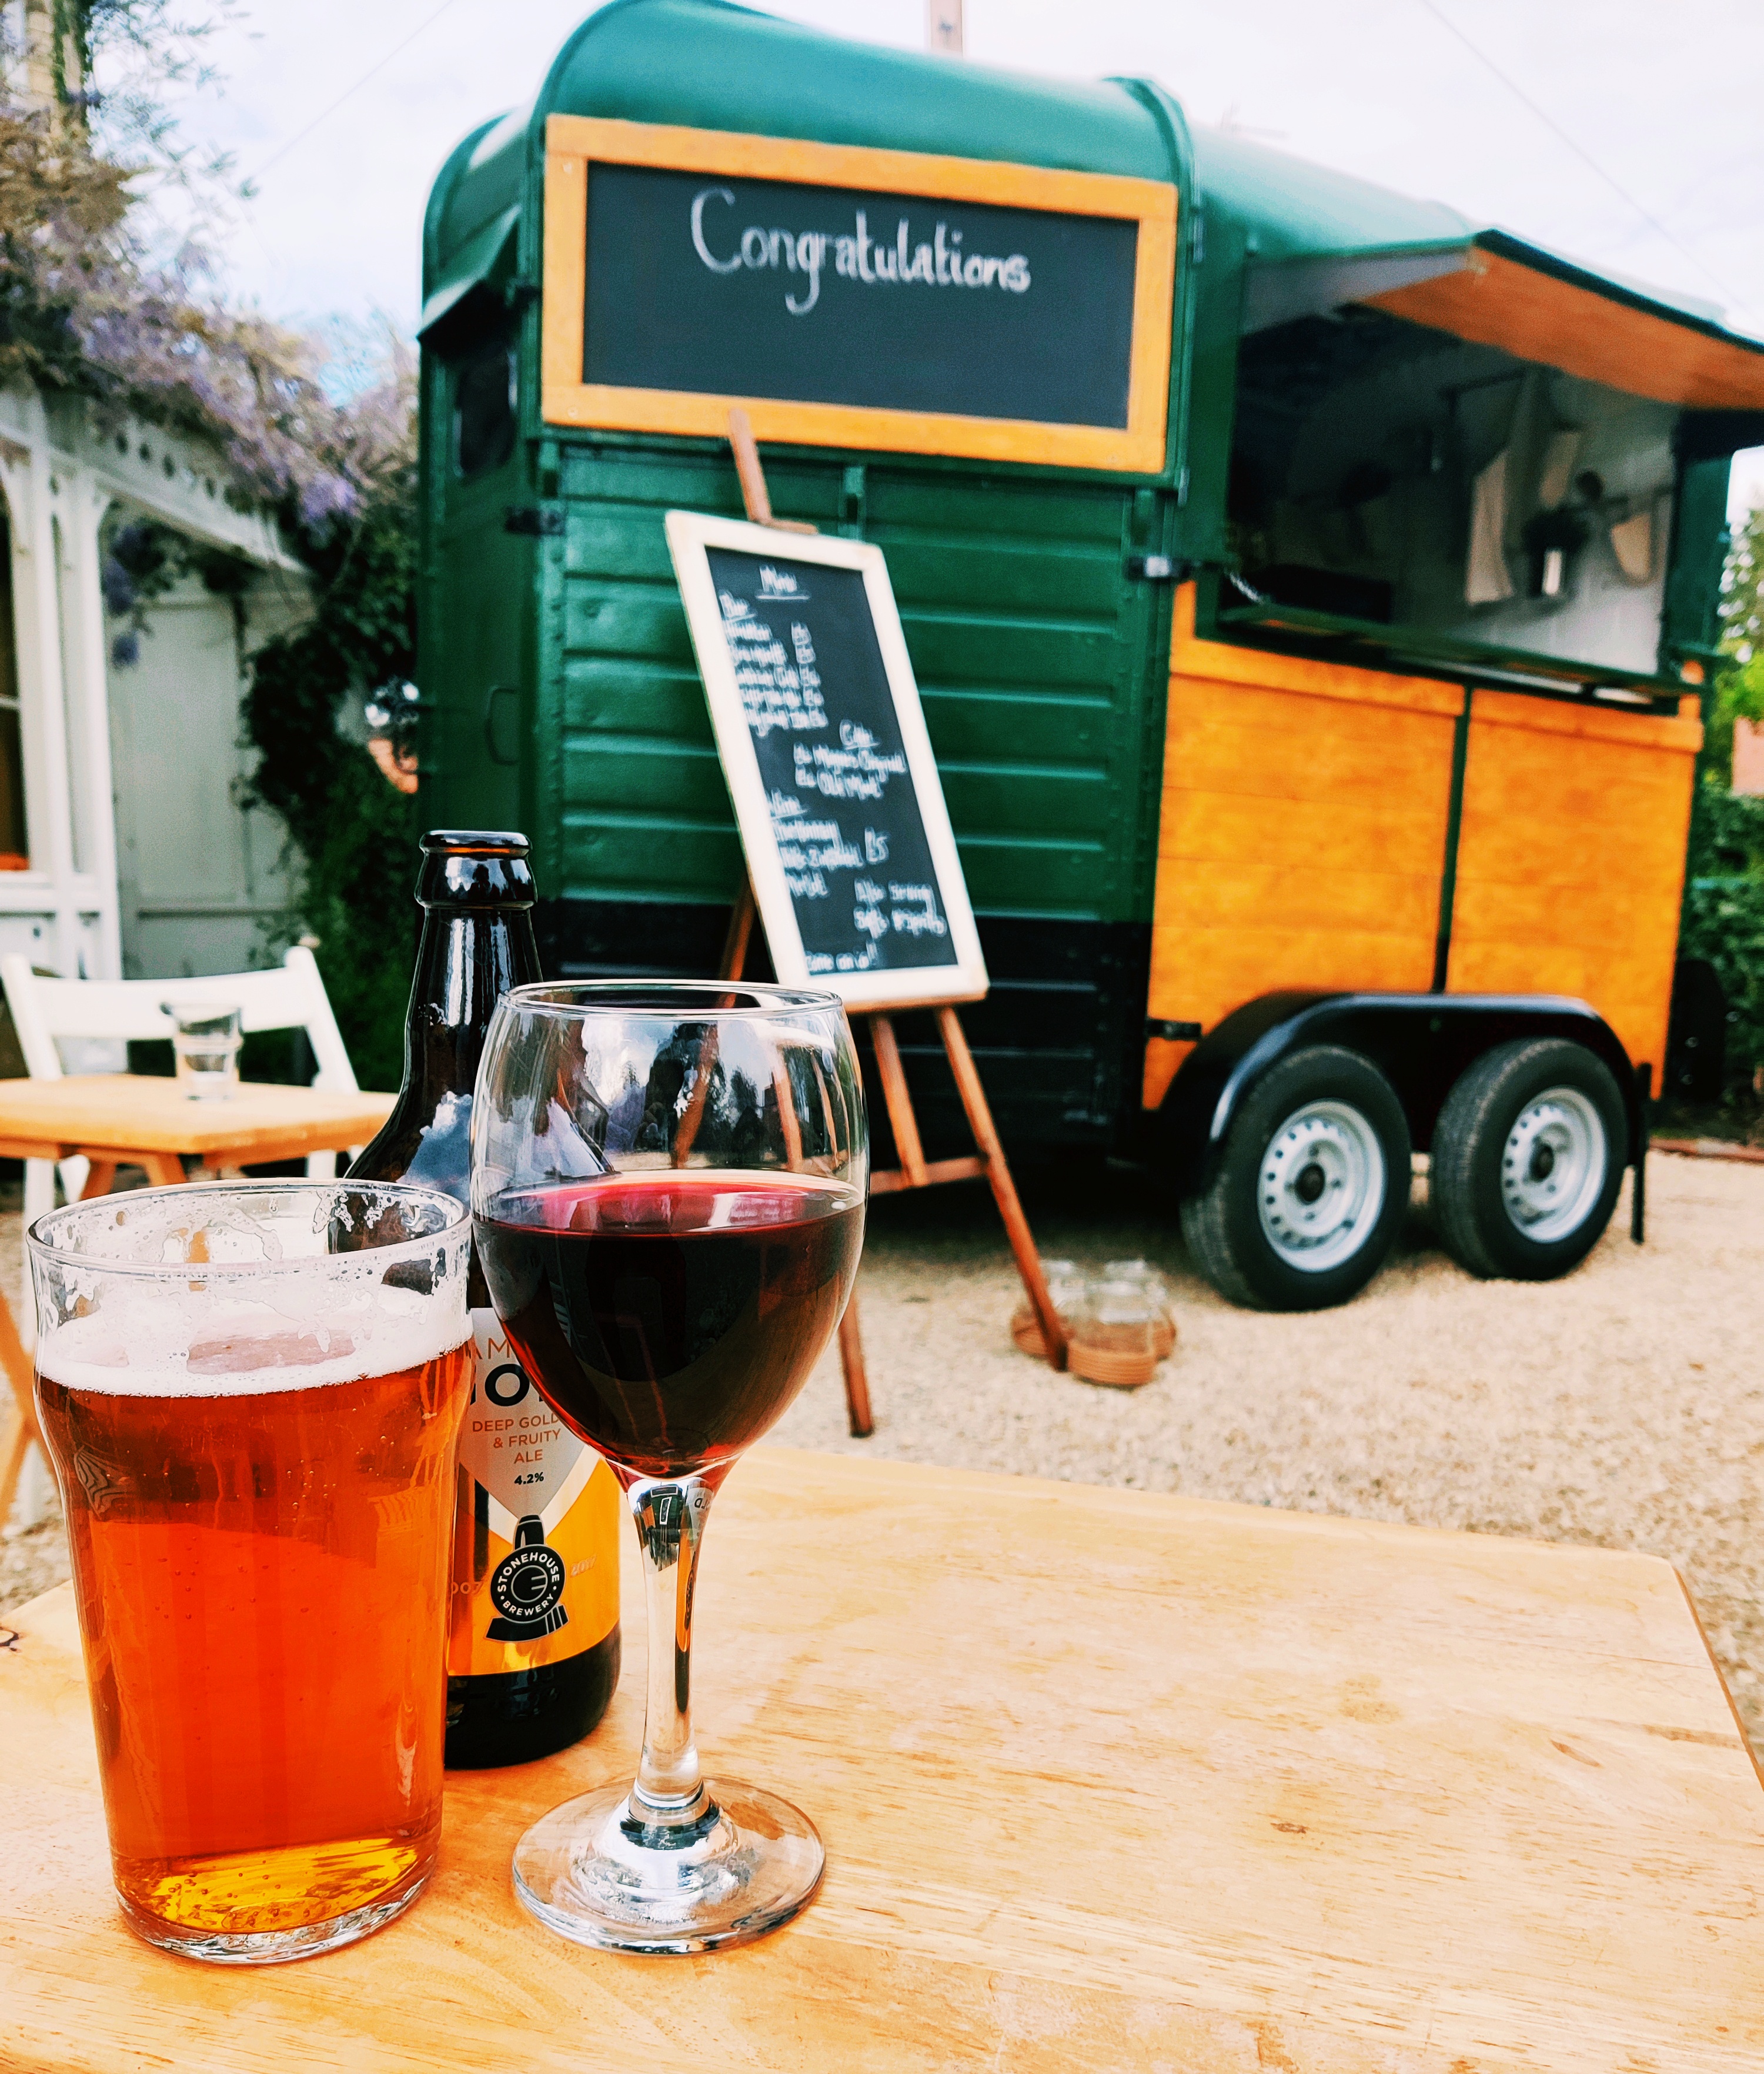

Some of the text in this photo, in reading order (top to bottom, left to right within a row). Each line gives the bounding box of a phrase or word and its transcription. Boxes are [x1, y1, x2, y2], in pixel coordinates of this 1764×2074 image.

[690, 188, 1031, 316] Congratulations
[473, 1418, 514, 1432] DEEP
[493, 1428, 561, 1448] & FRUITY
[513, 1449, 543, 1464] ALE
[514, 1472, 544, 1485] 4.2%
[497, 1552, 560, 1592] STONEHOUSE
[503, 1593, 553, 1616] BREWERY
